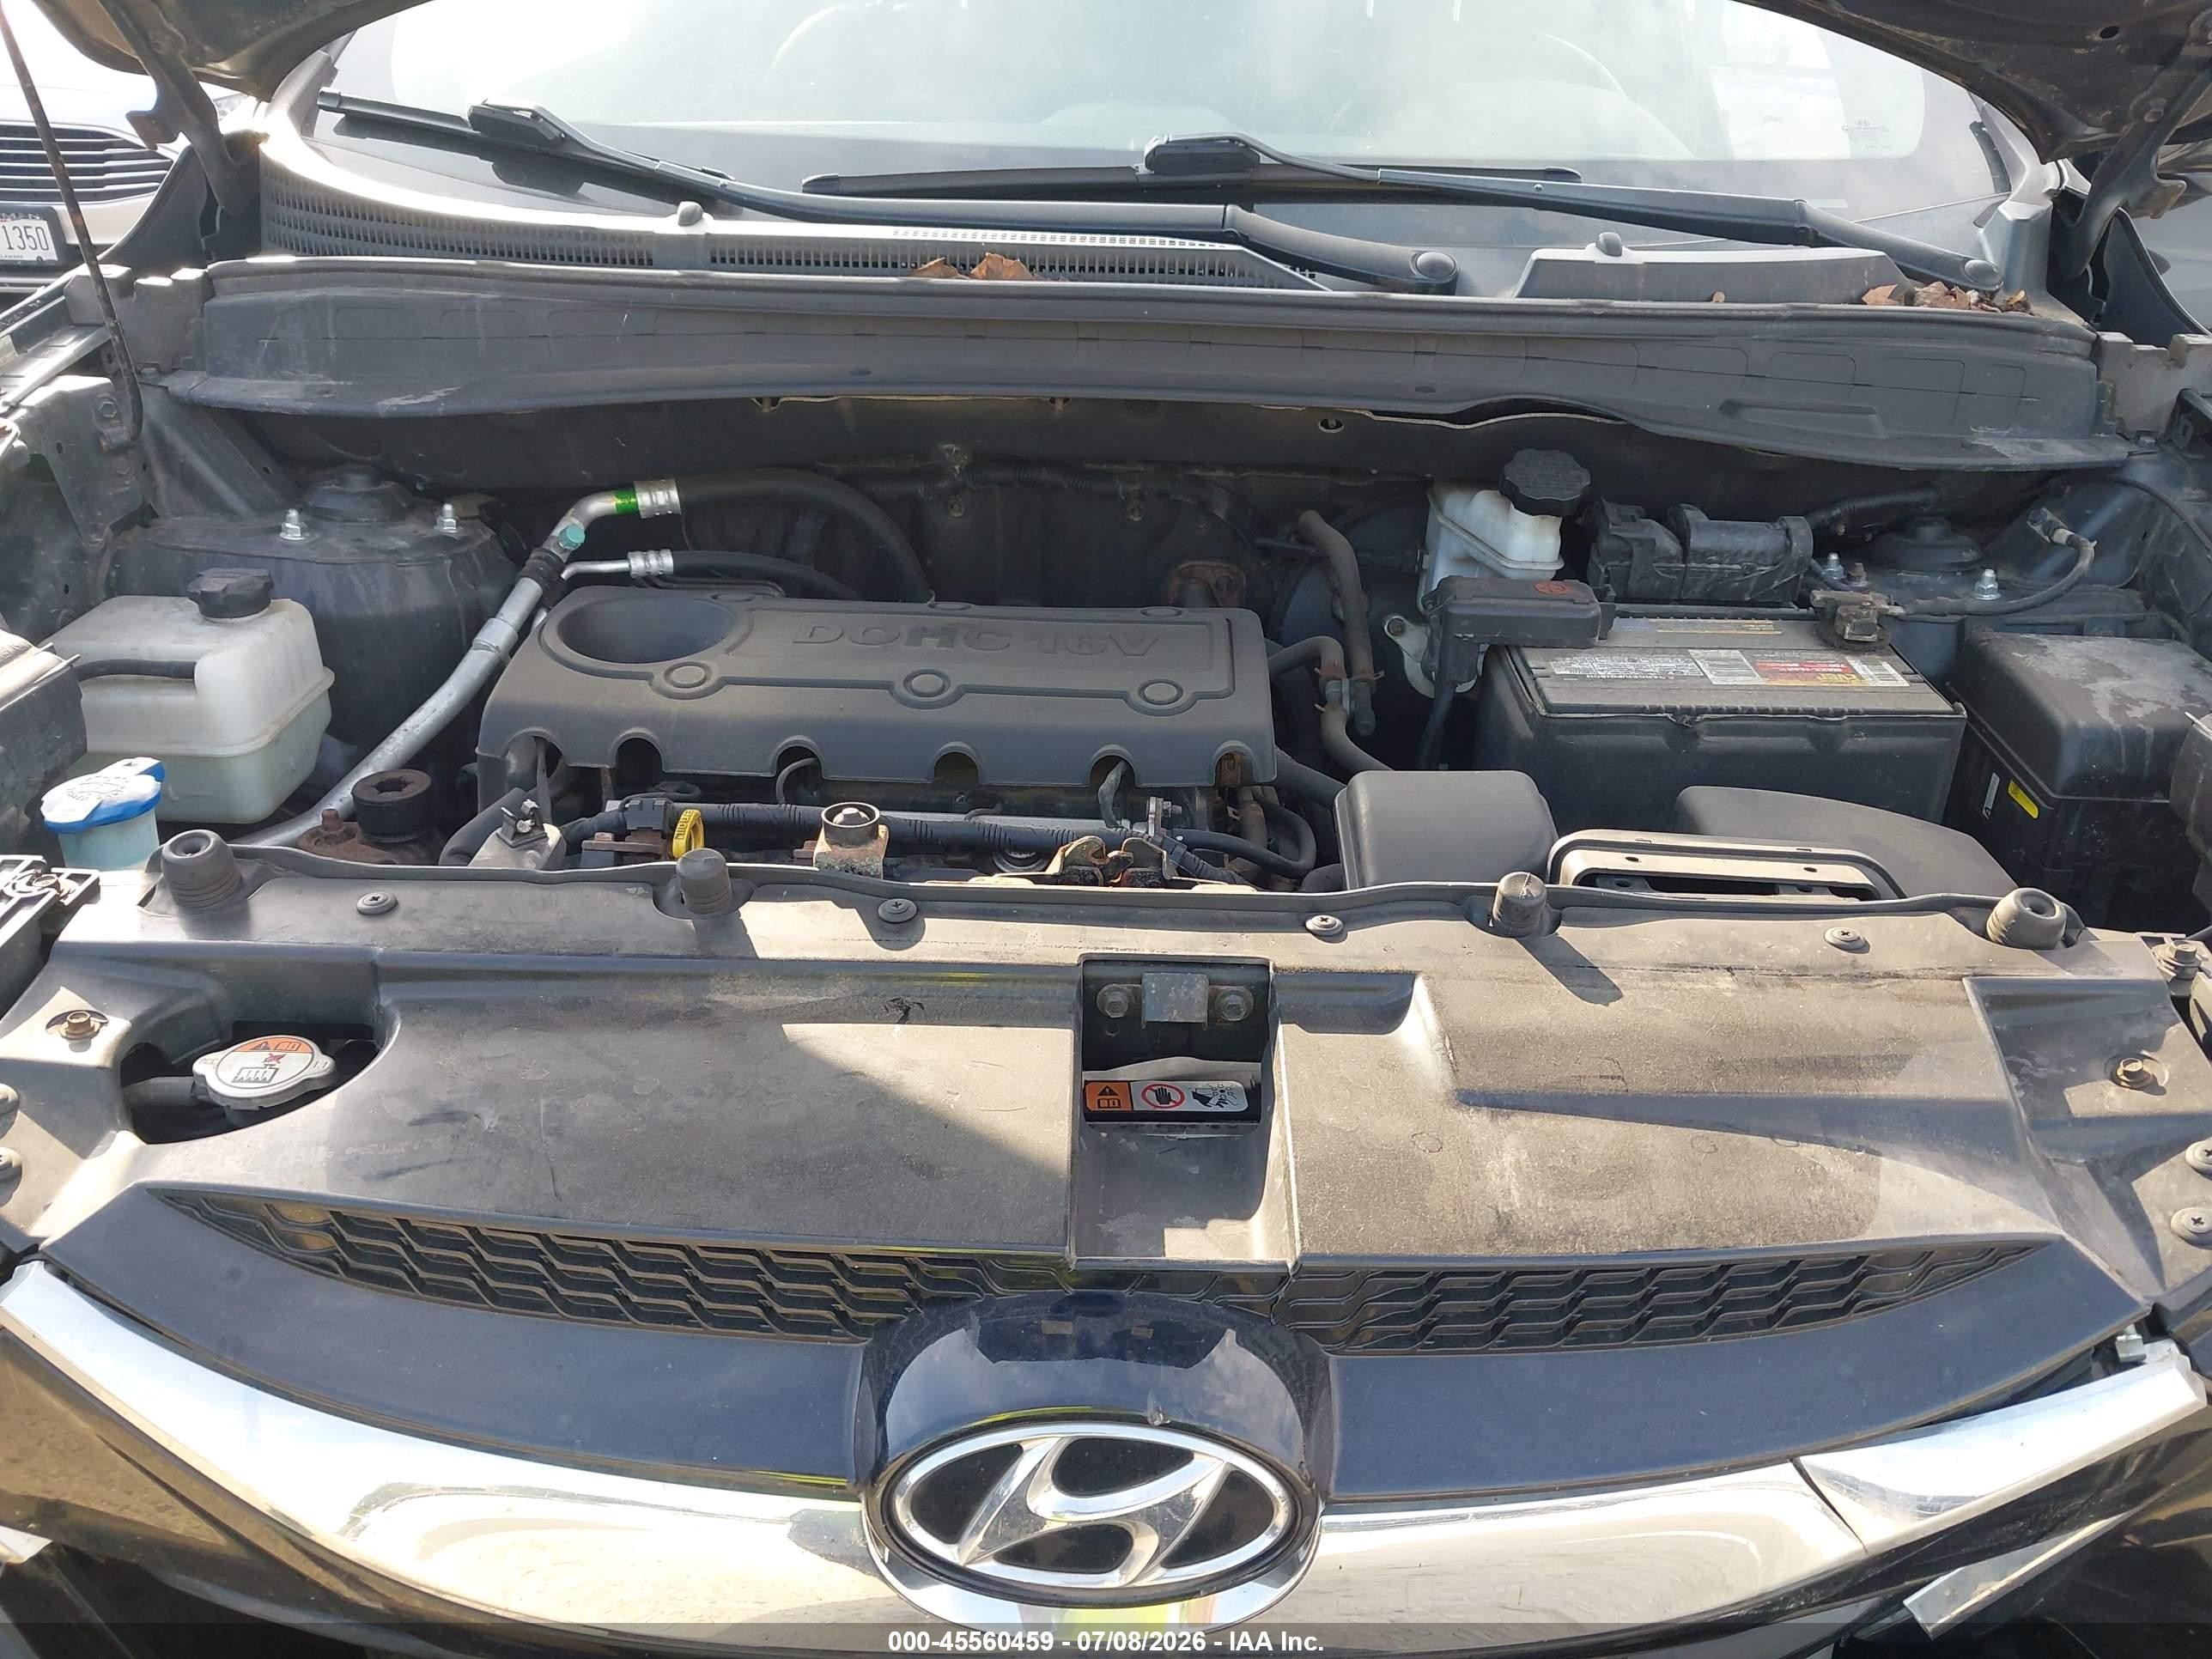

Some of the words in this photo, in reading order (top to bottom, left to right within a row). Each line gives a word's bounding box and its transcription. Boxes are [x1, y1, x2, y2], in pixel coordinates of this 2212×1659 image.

[2, 225, 50, 251] 1350
[793, 624, 1012, 653] DOHC
[1024, 632, 1162, 658] 16V
